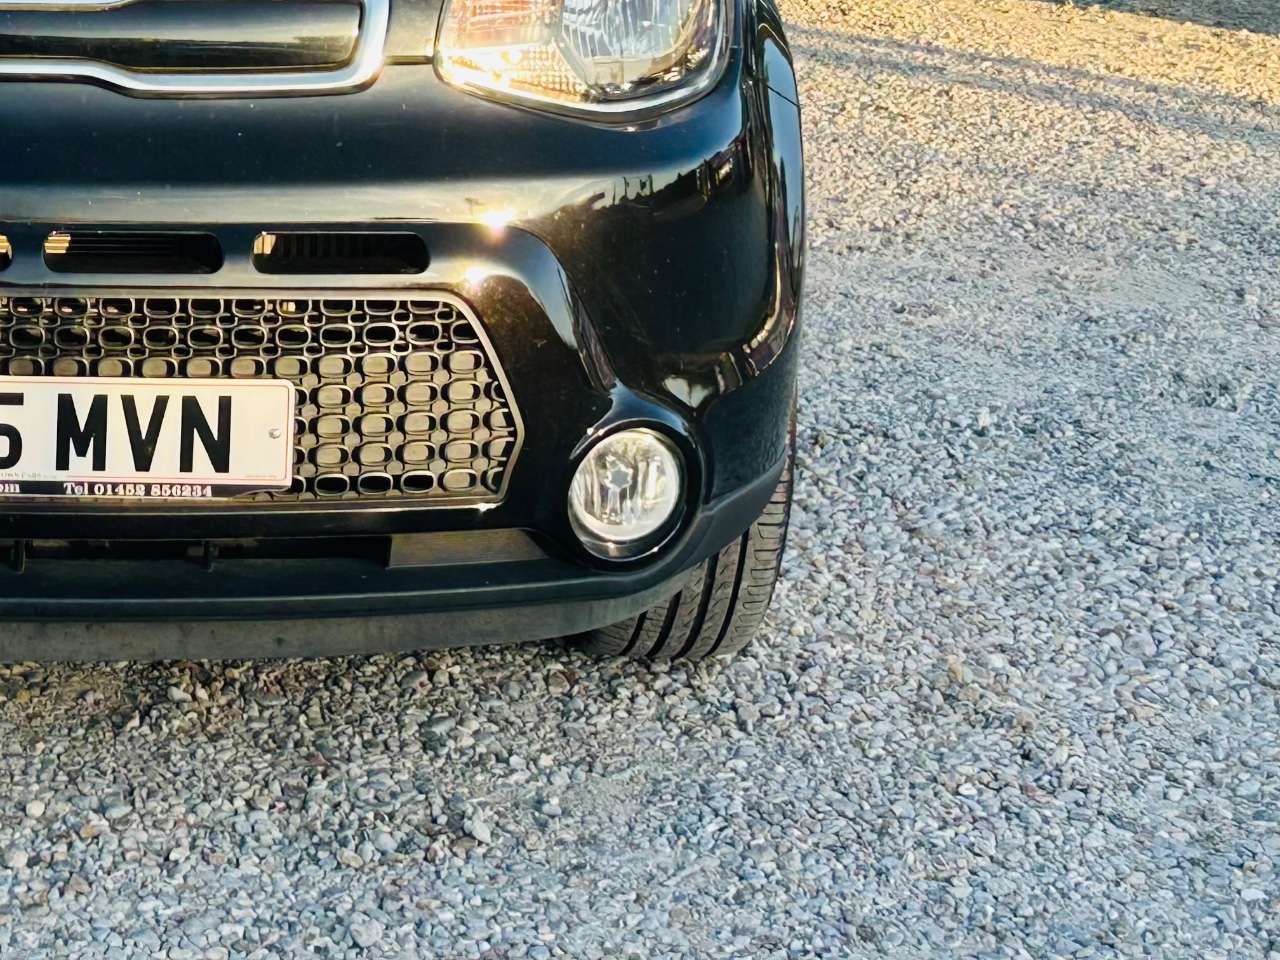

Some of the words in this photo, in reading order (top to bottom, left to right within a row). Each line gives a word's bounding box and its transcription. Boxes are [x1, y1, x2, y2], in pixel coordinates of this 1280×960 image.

[55, 393, 233, 474] MVN
[63, 482, 89, 496] Tel
[94, 482, 146, 497] 01452
[150, 484, 213, 498] 856234
